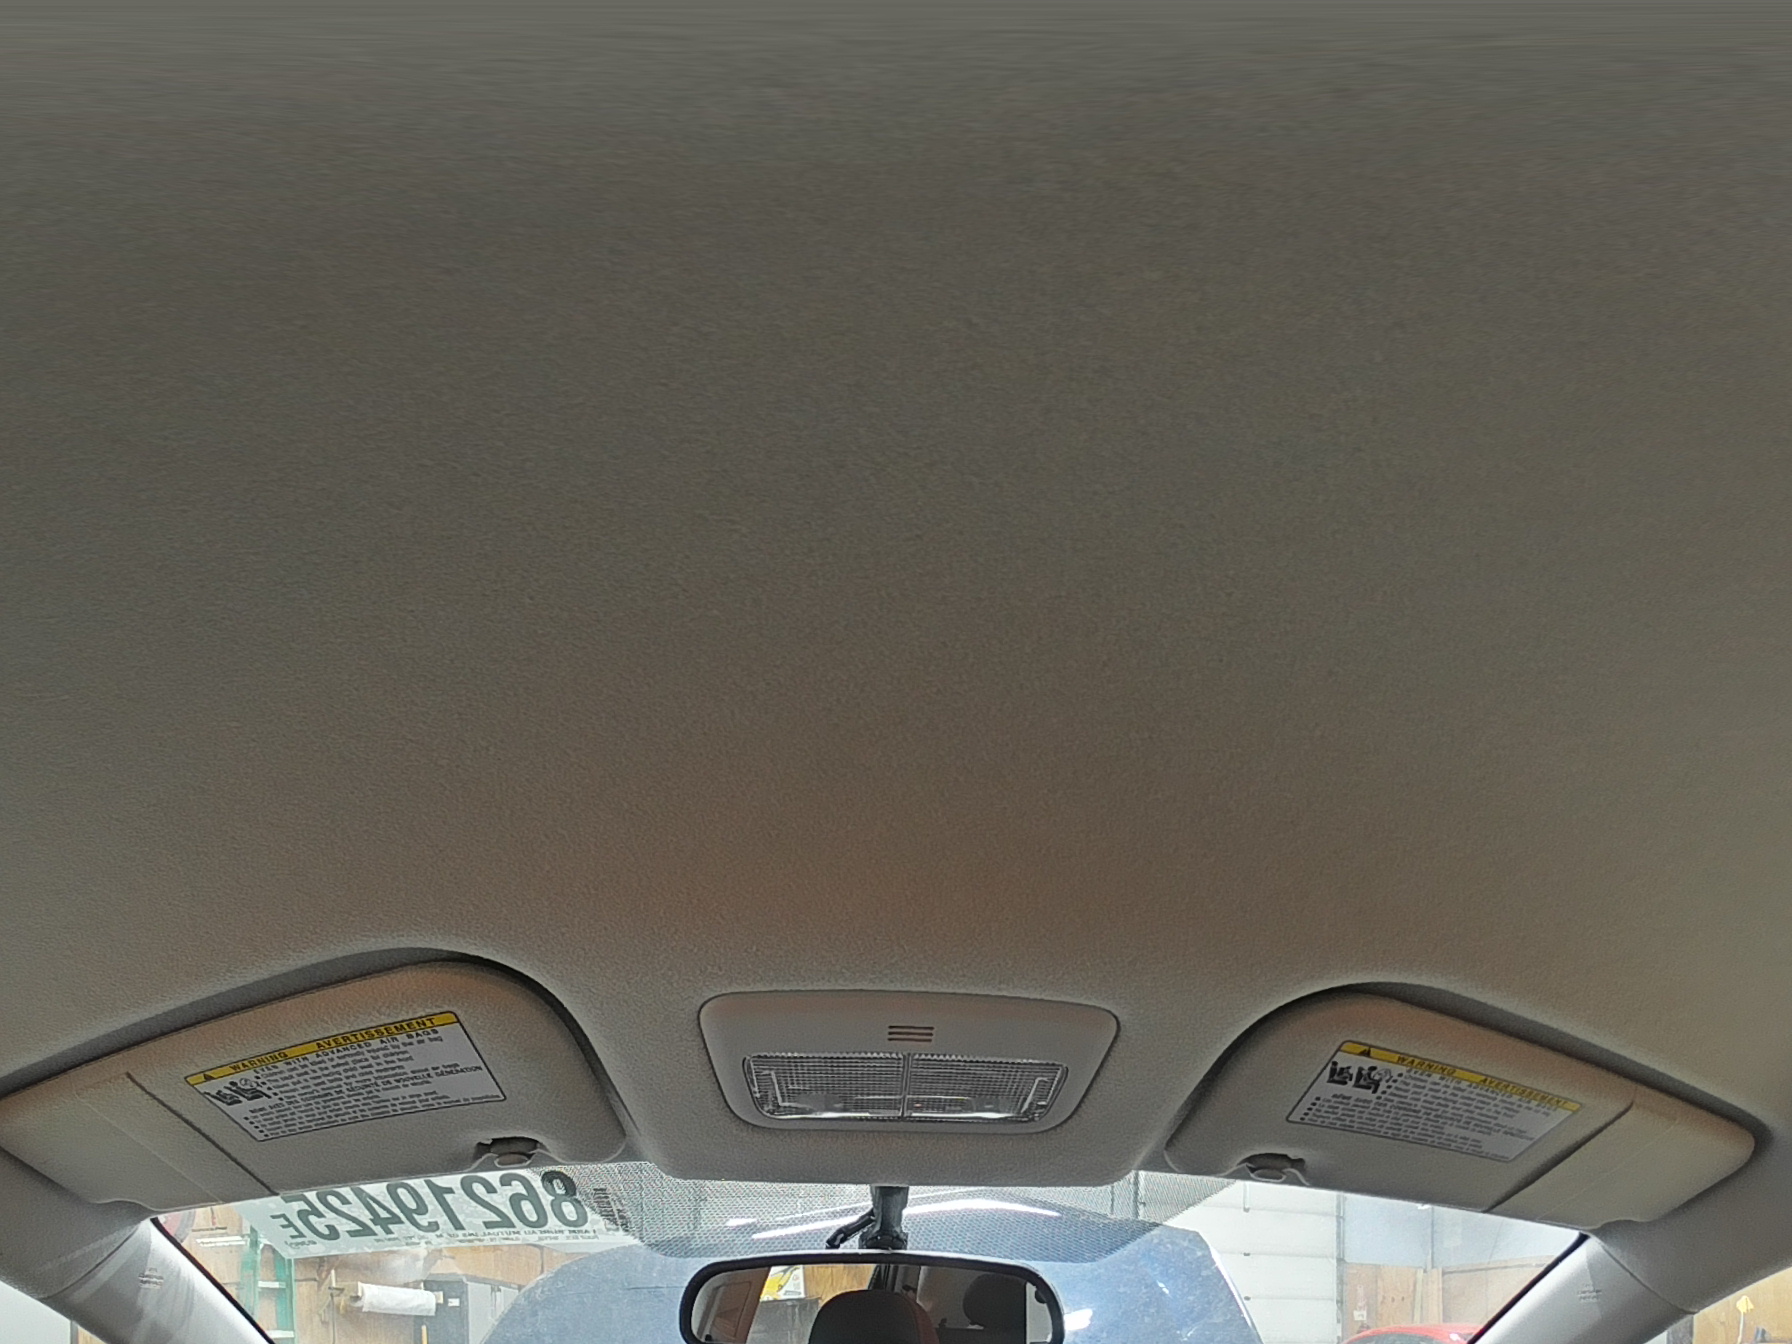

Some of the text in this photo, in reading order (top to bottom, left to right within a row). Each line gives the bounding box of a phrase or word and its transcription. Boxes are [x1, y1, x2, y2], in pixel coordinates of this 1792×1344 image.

[230, 1052, 289, 1072] WARNING
[316, 1018, 437, 1050] AVERTISSEMENT
[285, 1056, 309, 1067] WITH
[316, 1042, 372, 1058] ADVANCED
[380, 1037, 399, 1046] AIR
[407, 1029, 439, 1039] BAGS
[1397, 1054, 1457, 1075] WARNING
[1479, 1077, 1569, 1107] AVERTISSEMENT
